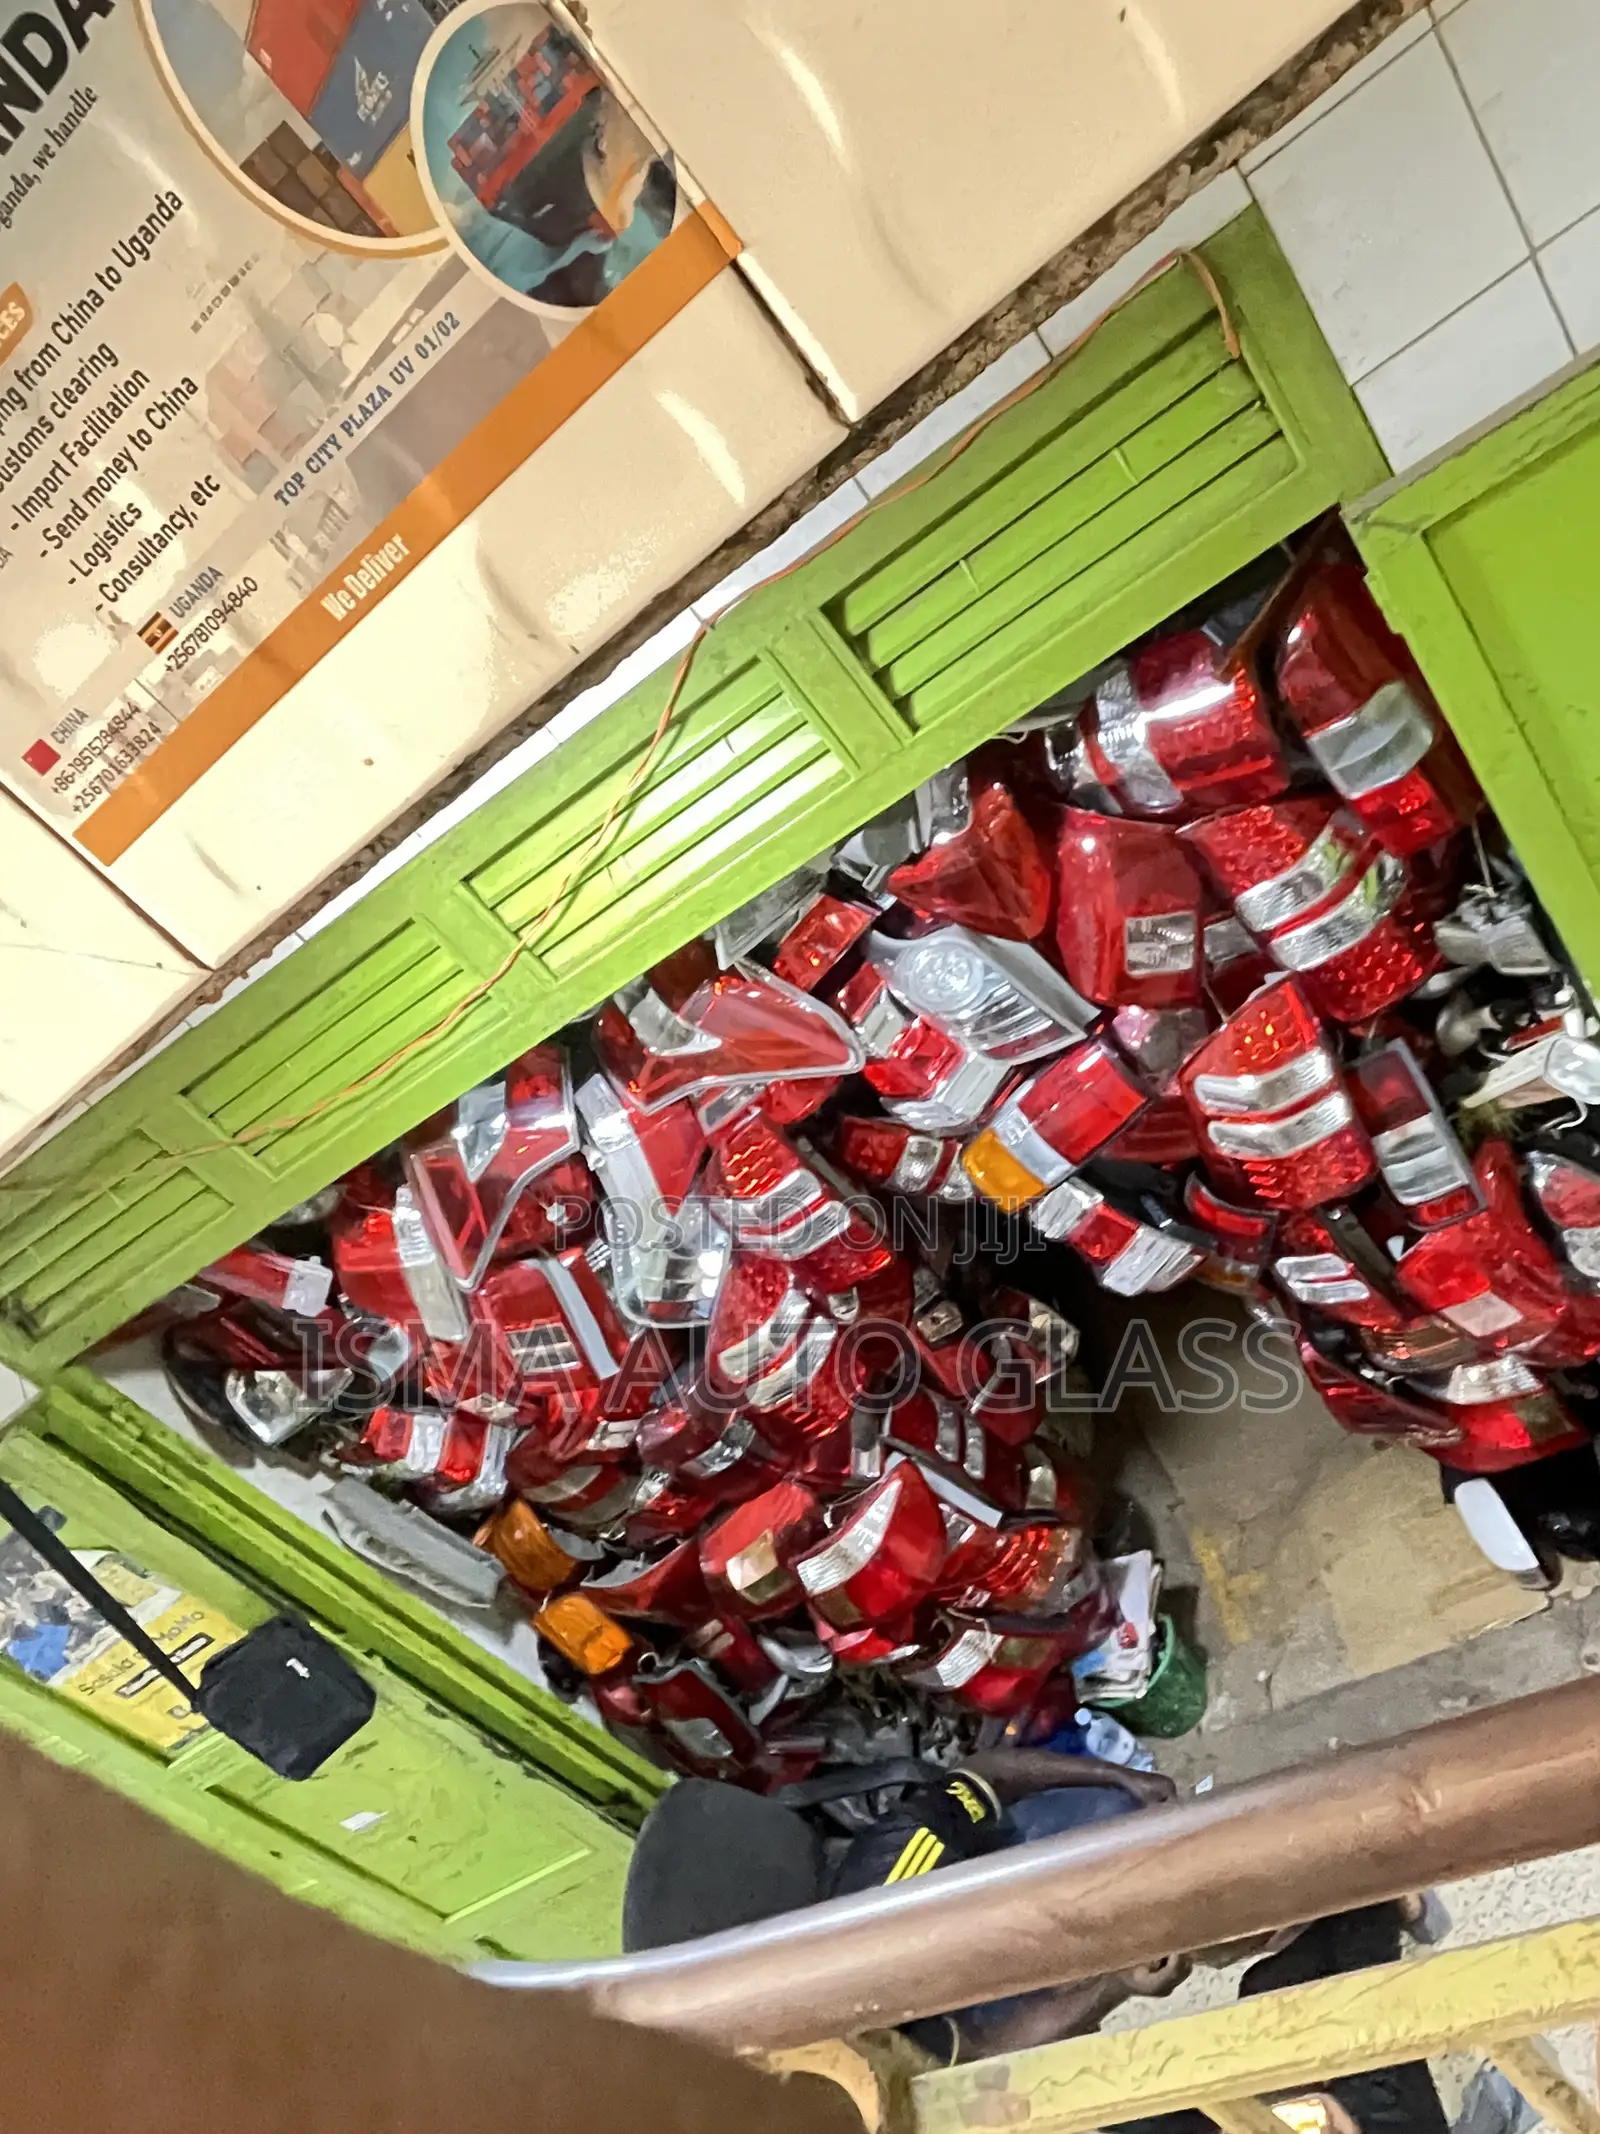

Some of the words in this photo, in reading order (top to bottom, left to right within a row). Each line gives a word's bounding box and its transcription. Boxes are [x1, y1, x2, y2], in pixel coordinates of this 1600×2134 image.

[0, 0, 118, 156] NDA
[44, 86, 99, 148] handle
[32, 143, 57, 171] we
[13, 342, 62, 392] from
[50, 288, 105, 345] China
[94, 265, 122, 292] to
[111, 190, 184, 268] Uganda
[0, 415, 55, 493] ustoms
[50, 342, 119, 419] clearing
[11, 459, 72, 523] Import
[59, 369, 151, 468] Facilitation
[42, 498, 90, 550] Send
[82, 446, 138, 509] money
[127, 428, 153, 451] to
[145, 376, 199, 430] China
[273, 471, 306, 507] TOP
[305, 432, 343, 474] CITY
[339, 384, 393, 438] PLAZA
[389, 355, 415, 385] UV
[414, 311, 461, 360] 01/02
[69, 502, 142, 578] Logistics
[98, 503, 199, 604] Consultancy,
[190, 474, 221, 507] etc
[168, 566, 224, 618] UGANDA
[320, 592, 357, 622] We
[343, 533, 410, 600] Deliver
[164, 576, 258, 673] +256781094840
[50, 707, 89, 745] CHINA
